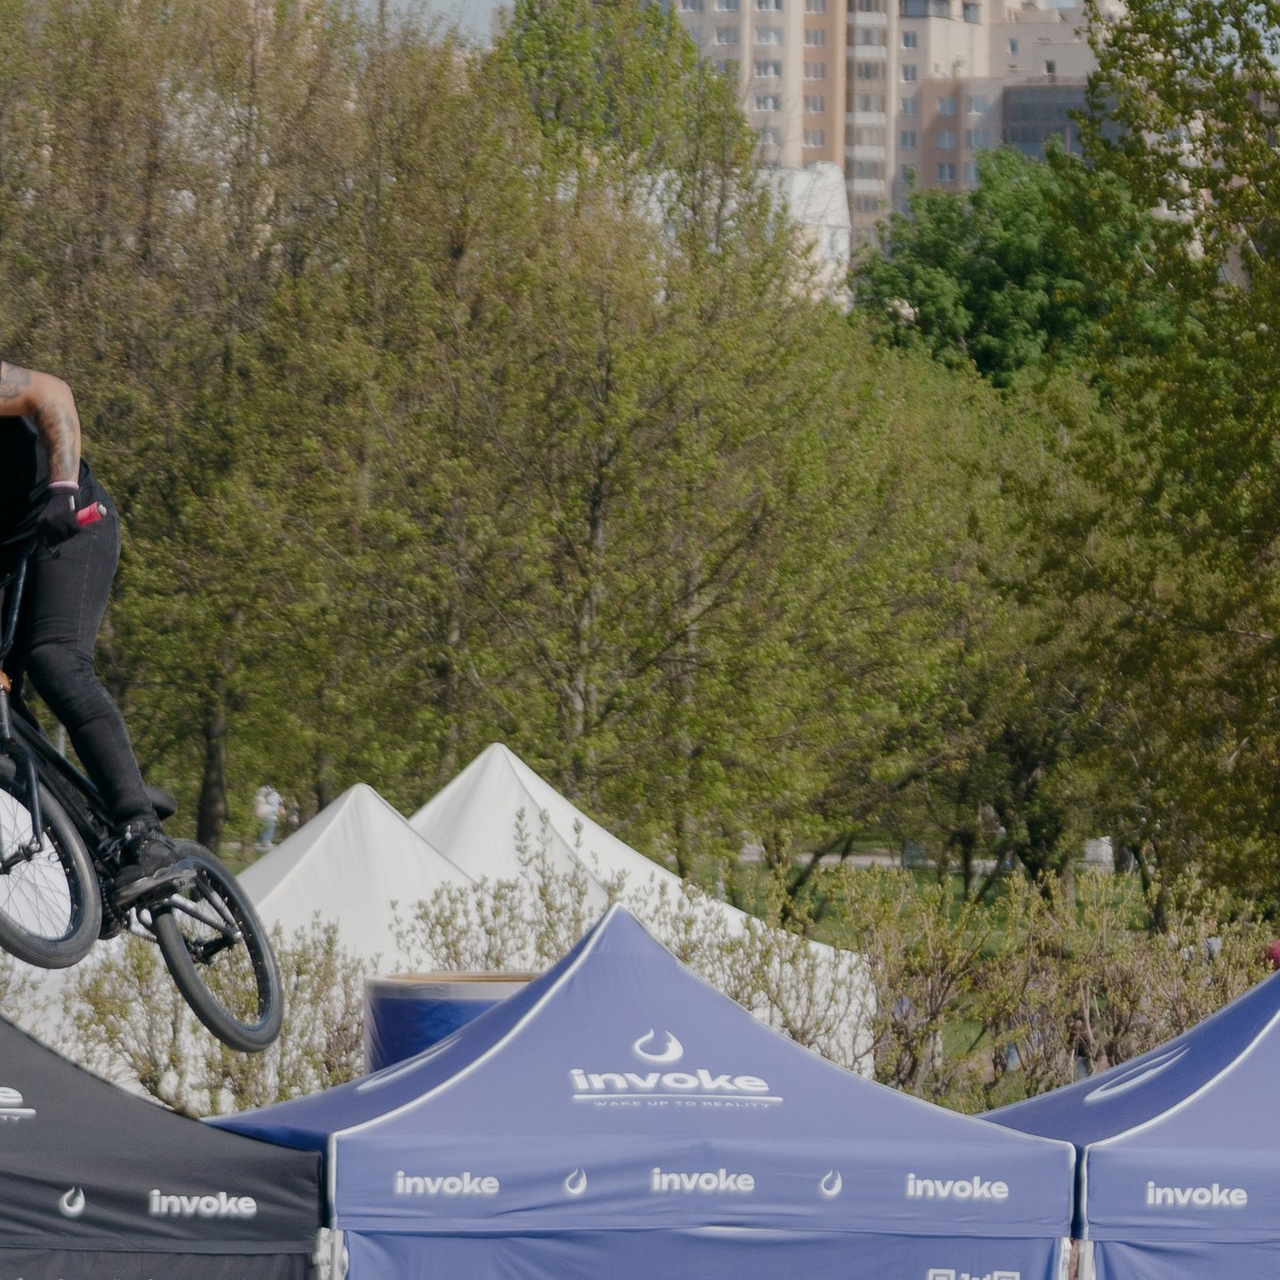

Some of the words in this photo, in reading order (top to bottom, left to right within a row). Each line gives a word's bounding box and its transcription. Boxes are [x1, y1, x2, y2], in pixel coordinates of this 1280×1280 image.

[569, 1069, 769, 1091] invoke
[396, 1171, 499, 1194] invoke
[653, 1168, 754, 1191] invoke
[908, 1173, 1008, 1199] invoke
[150, 1189, 256, 1215] invoke
[1147, 1181, 1247, 1205] invoke
